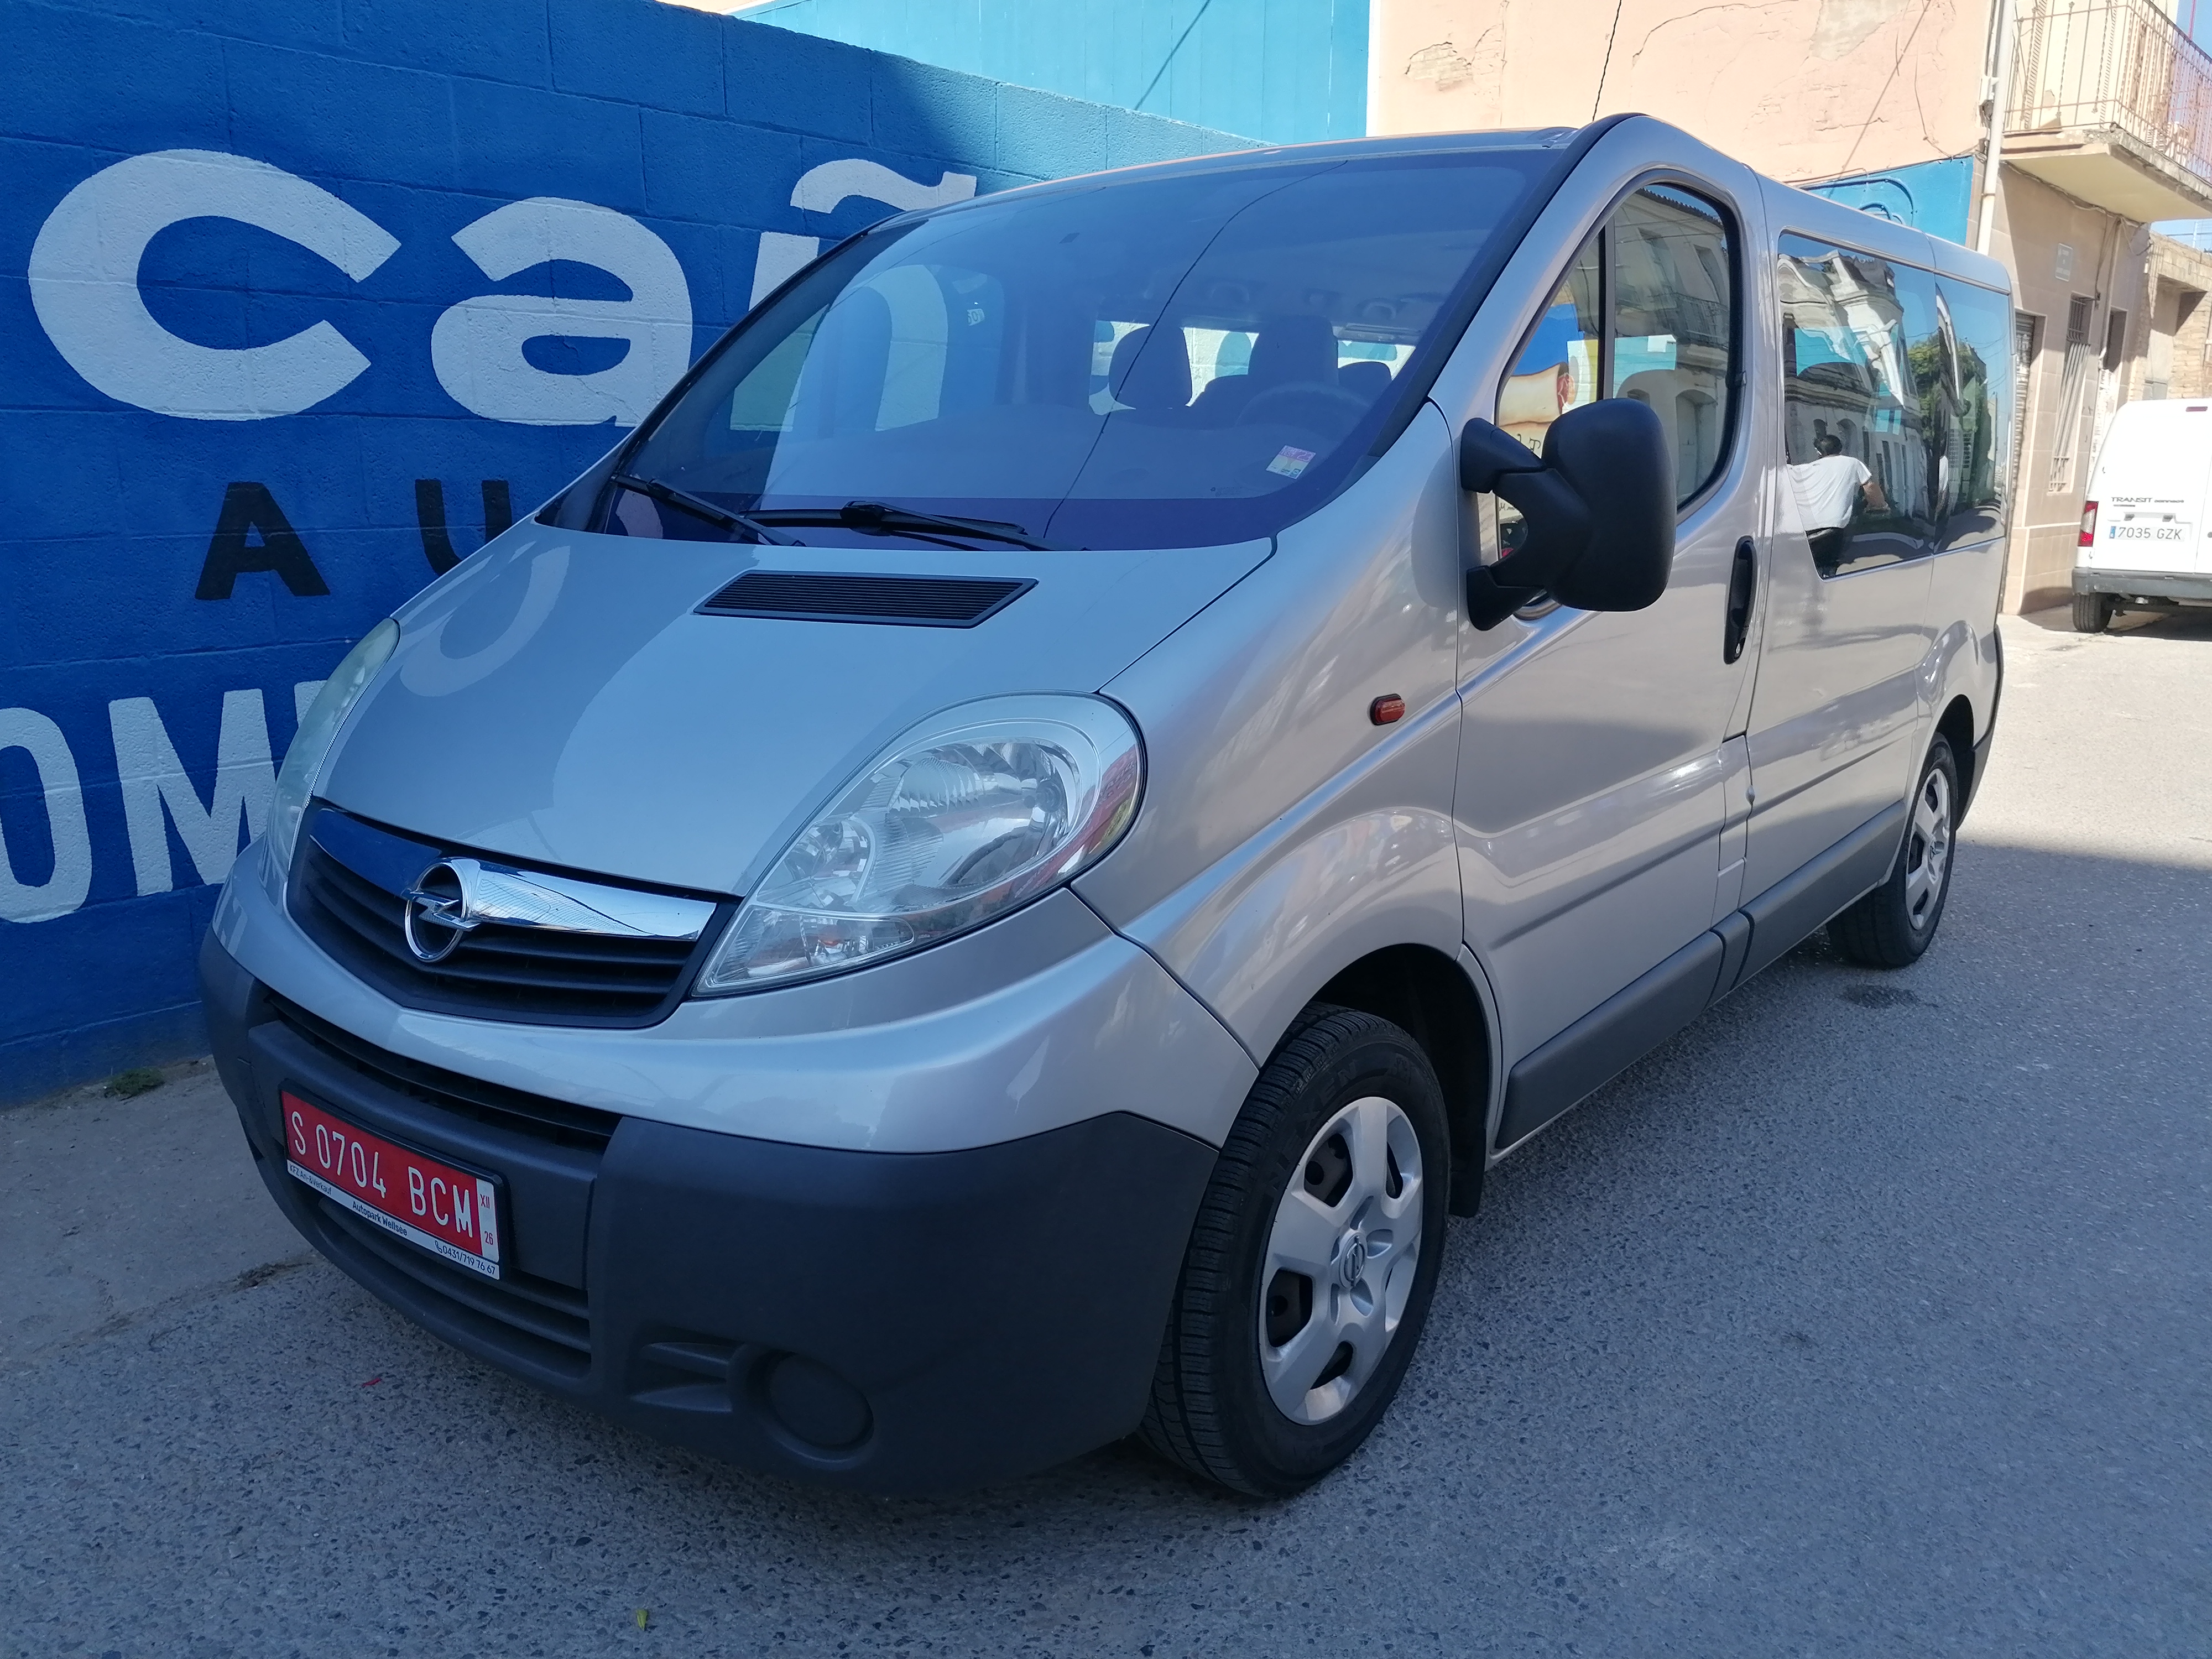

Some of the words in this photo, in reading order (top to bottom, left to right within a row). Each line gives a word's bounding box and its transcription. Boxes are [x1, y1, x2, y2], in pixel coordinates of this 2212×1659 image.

[2118, 526, 2151, 539] 7035
[2157, 528, 2183, 540] GZK
[291, 1110, 306, 1155] S
[316, 1124, 387, 1199] 0704
[408, 1166, 473, 1238] BCM
[480, 1193, 491, 1209] XII
[352, 1201, 382, 1223] Autopark
[382, 1217, 408, 1237] Wellsee
[484, 1230, 494, 1245] 26
[442, 1245, 475, 1266] 0431/719
[476, 1259, 486, 1271] 76
[487, 1264, 496, 1275] 67
